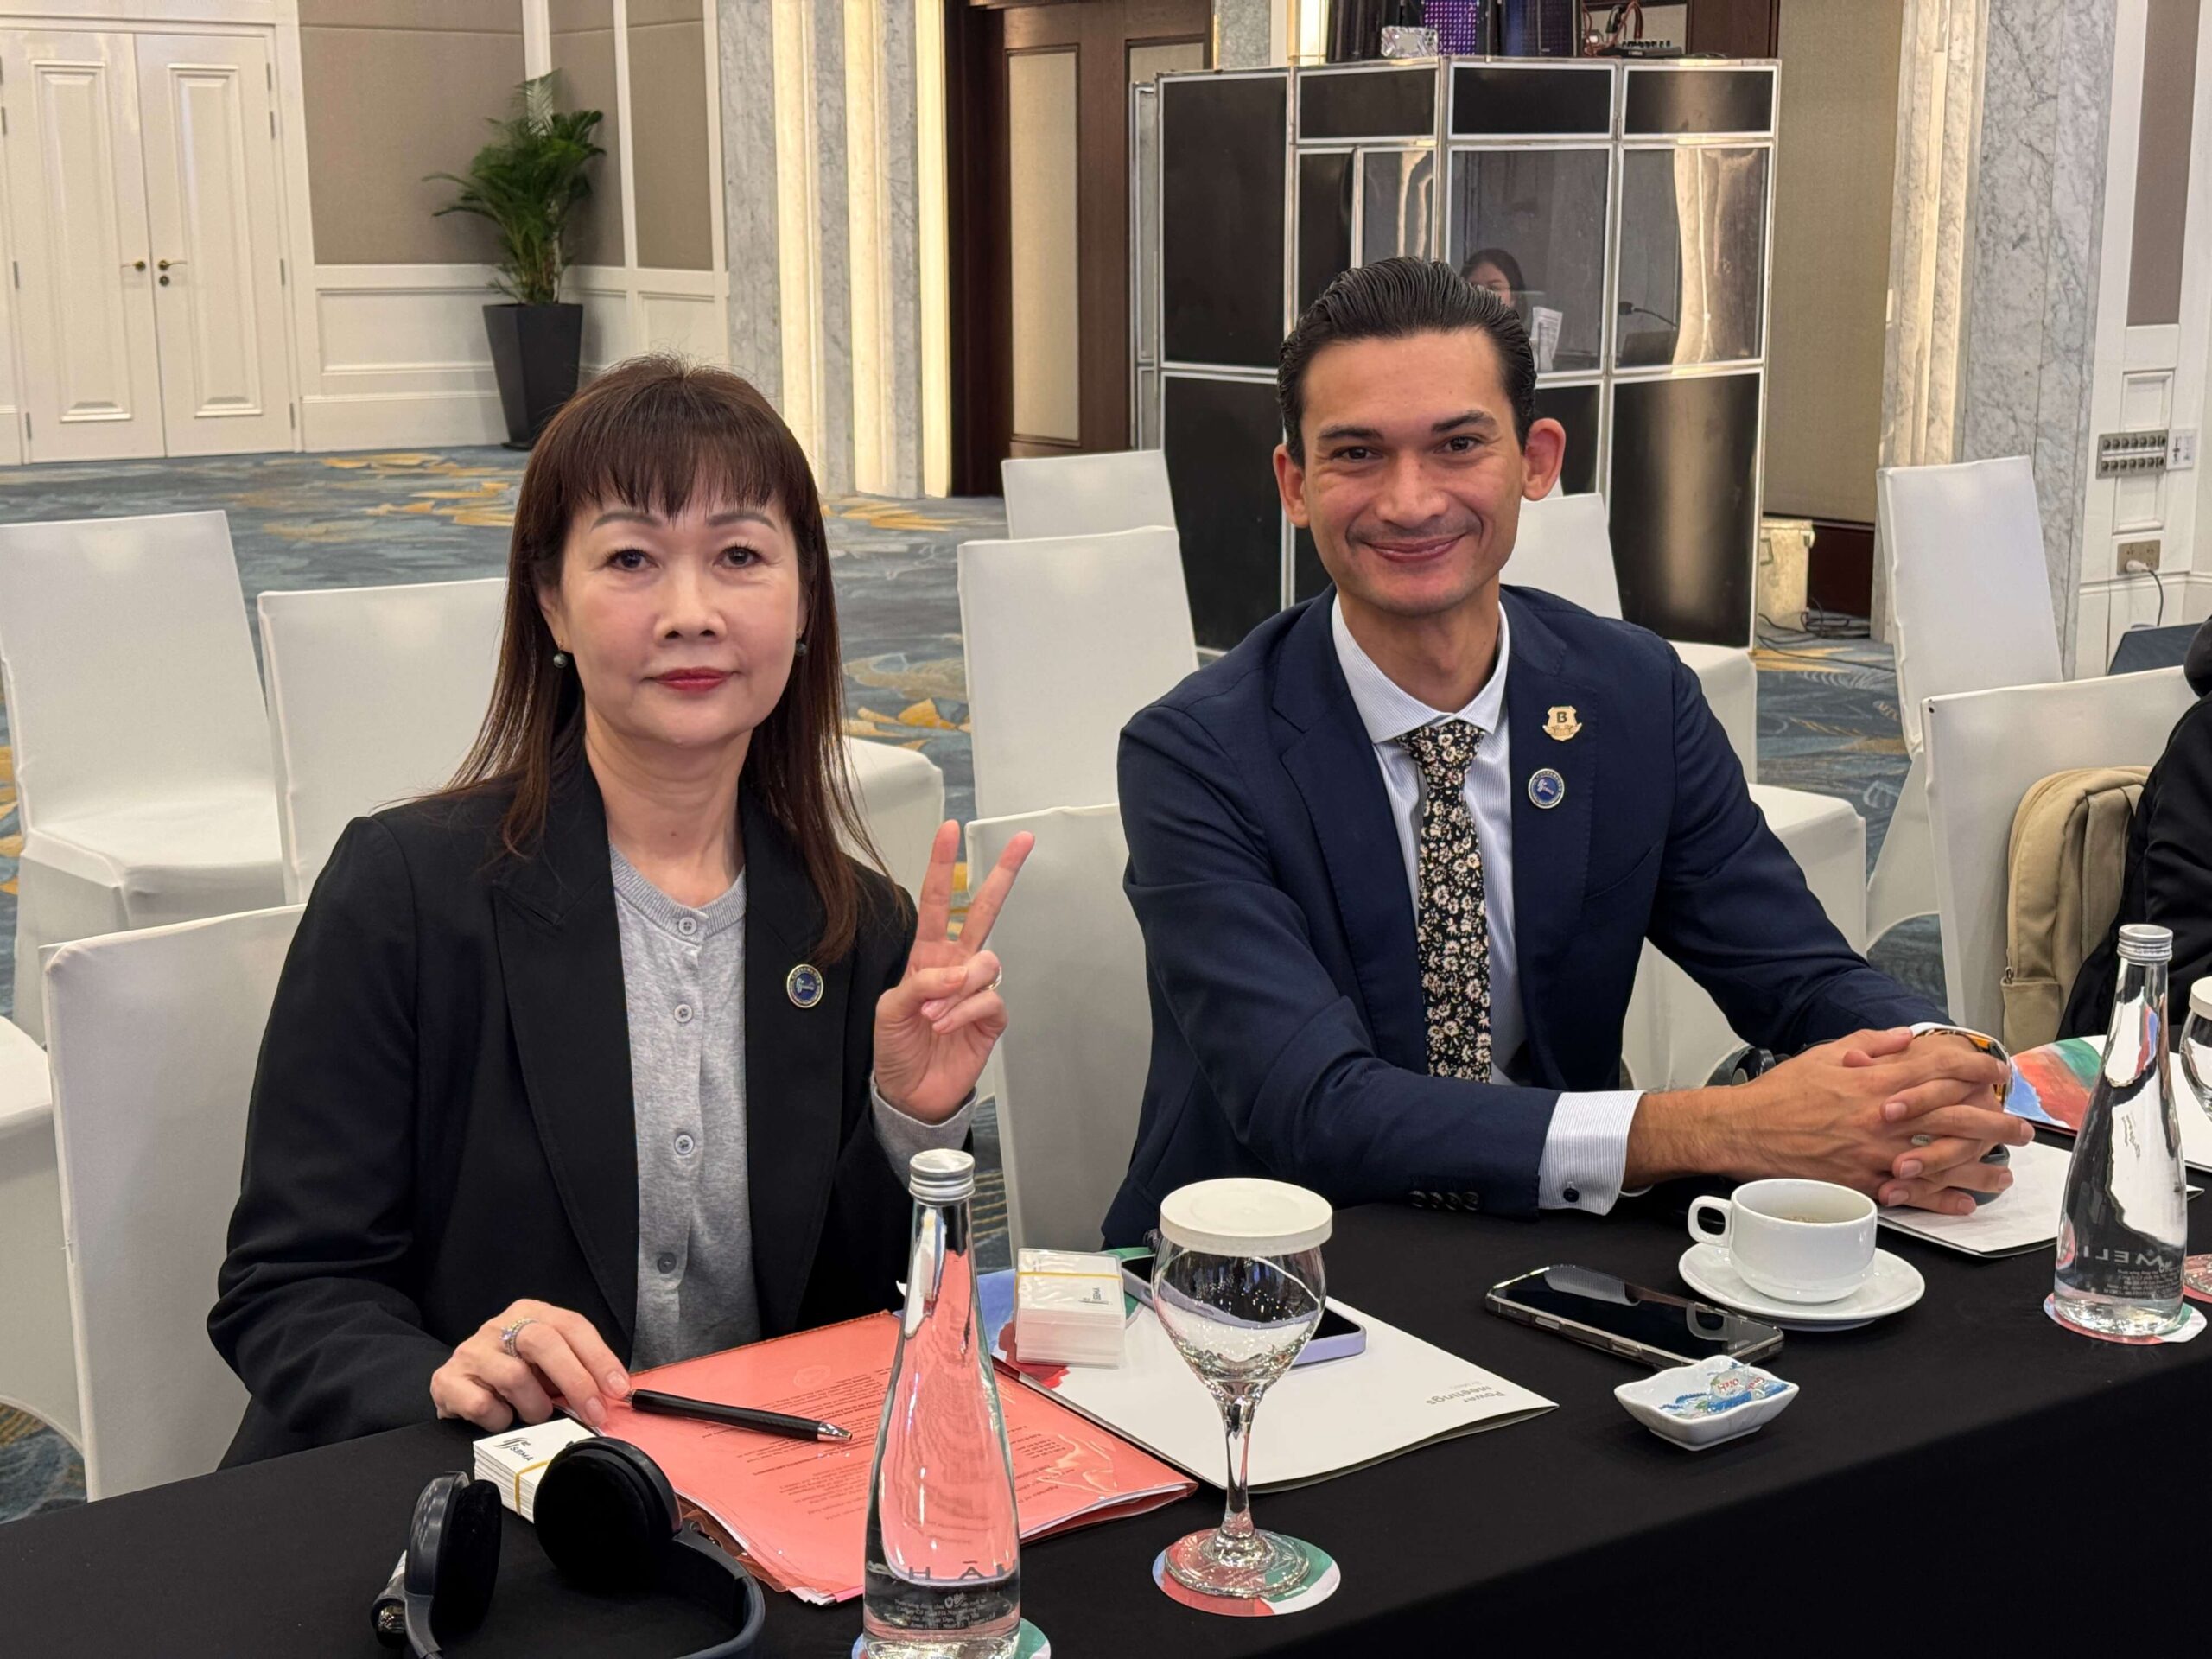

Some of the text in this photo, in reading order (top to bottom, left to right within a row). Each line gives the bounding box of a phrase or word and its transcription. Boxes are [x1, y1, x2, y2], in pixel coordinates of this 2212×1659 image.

[1556, 711, 1567, 723] B
[1426, 1385, 1493, 1406] Meetings
[1463, 1390, 1506, 1404] Power
[509, 1446, 534, 1461] SBMA
